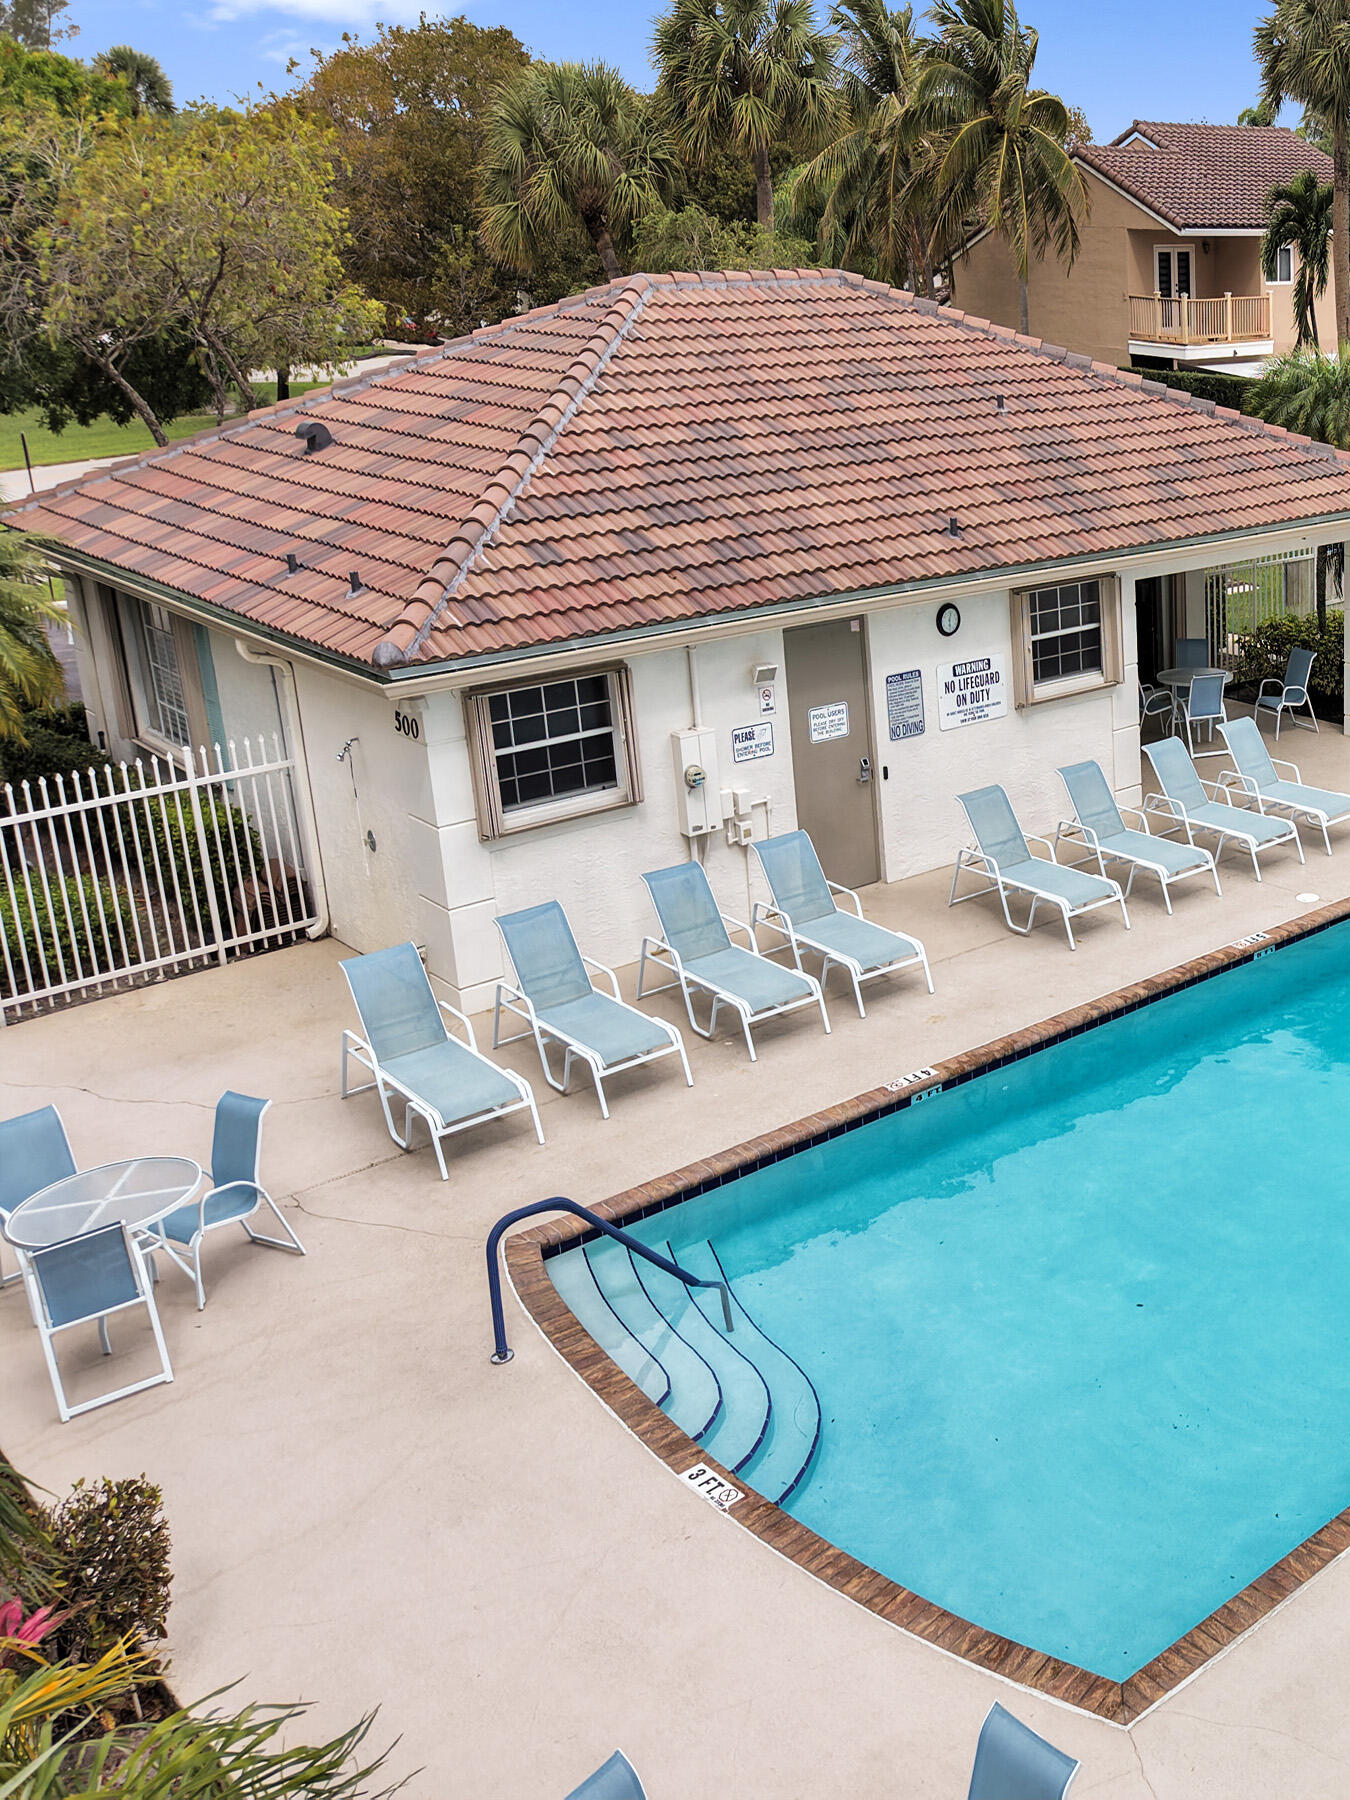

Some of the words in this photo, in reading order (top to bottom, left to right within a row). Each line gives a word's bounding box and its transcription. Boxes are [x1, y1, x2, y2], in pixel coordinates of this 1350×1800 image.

[954, 659, 989, 677] WARNING
[887, 674, 902, 683] POOL
[903, 671, 919, 680] RULES
[944, 680, 955, 695] NO
[958, 671, 1000, 691] LIFEGUARD
[956, 693, 967, 708] ON
[970, 688, 991, 704] DUTY
[827, 708, 845, 718] USERS
[395, 710, 419, 739] 500
[828, 721, 846, 730] ENTERING
[891, 724, 901, 739] NO
[902, 720, 924, 736] DIVING
[734, 729, 756, 744] PLEASE
[735, 744, 753, 754] SHOWER
[754, 740, 772, 749] BEFORE
[736, 749, 758, 759] ENTERING
[759, 746, 772, 754] POOL
[903, 1073, 922, 1084] FT
[927, 1087, 940, 1097] FT
[688, 1469, 707, 1480] 3
